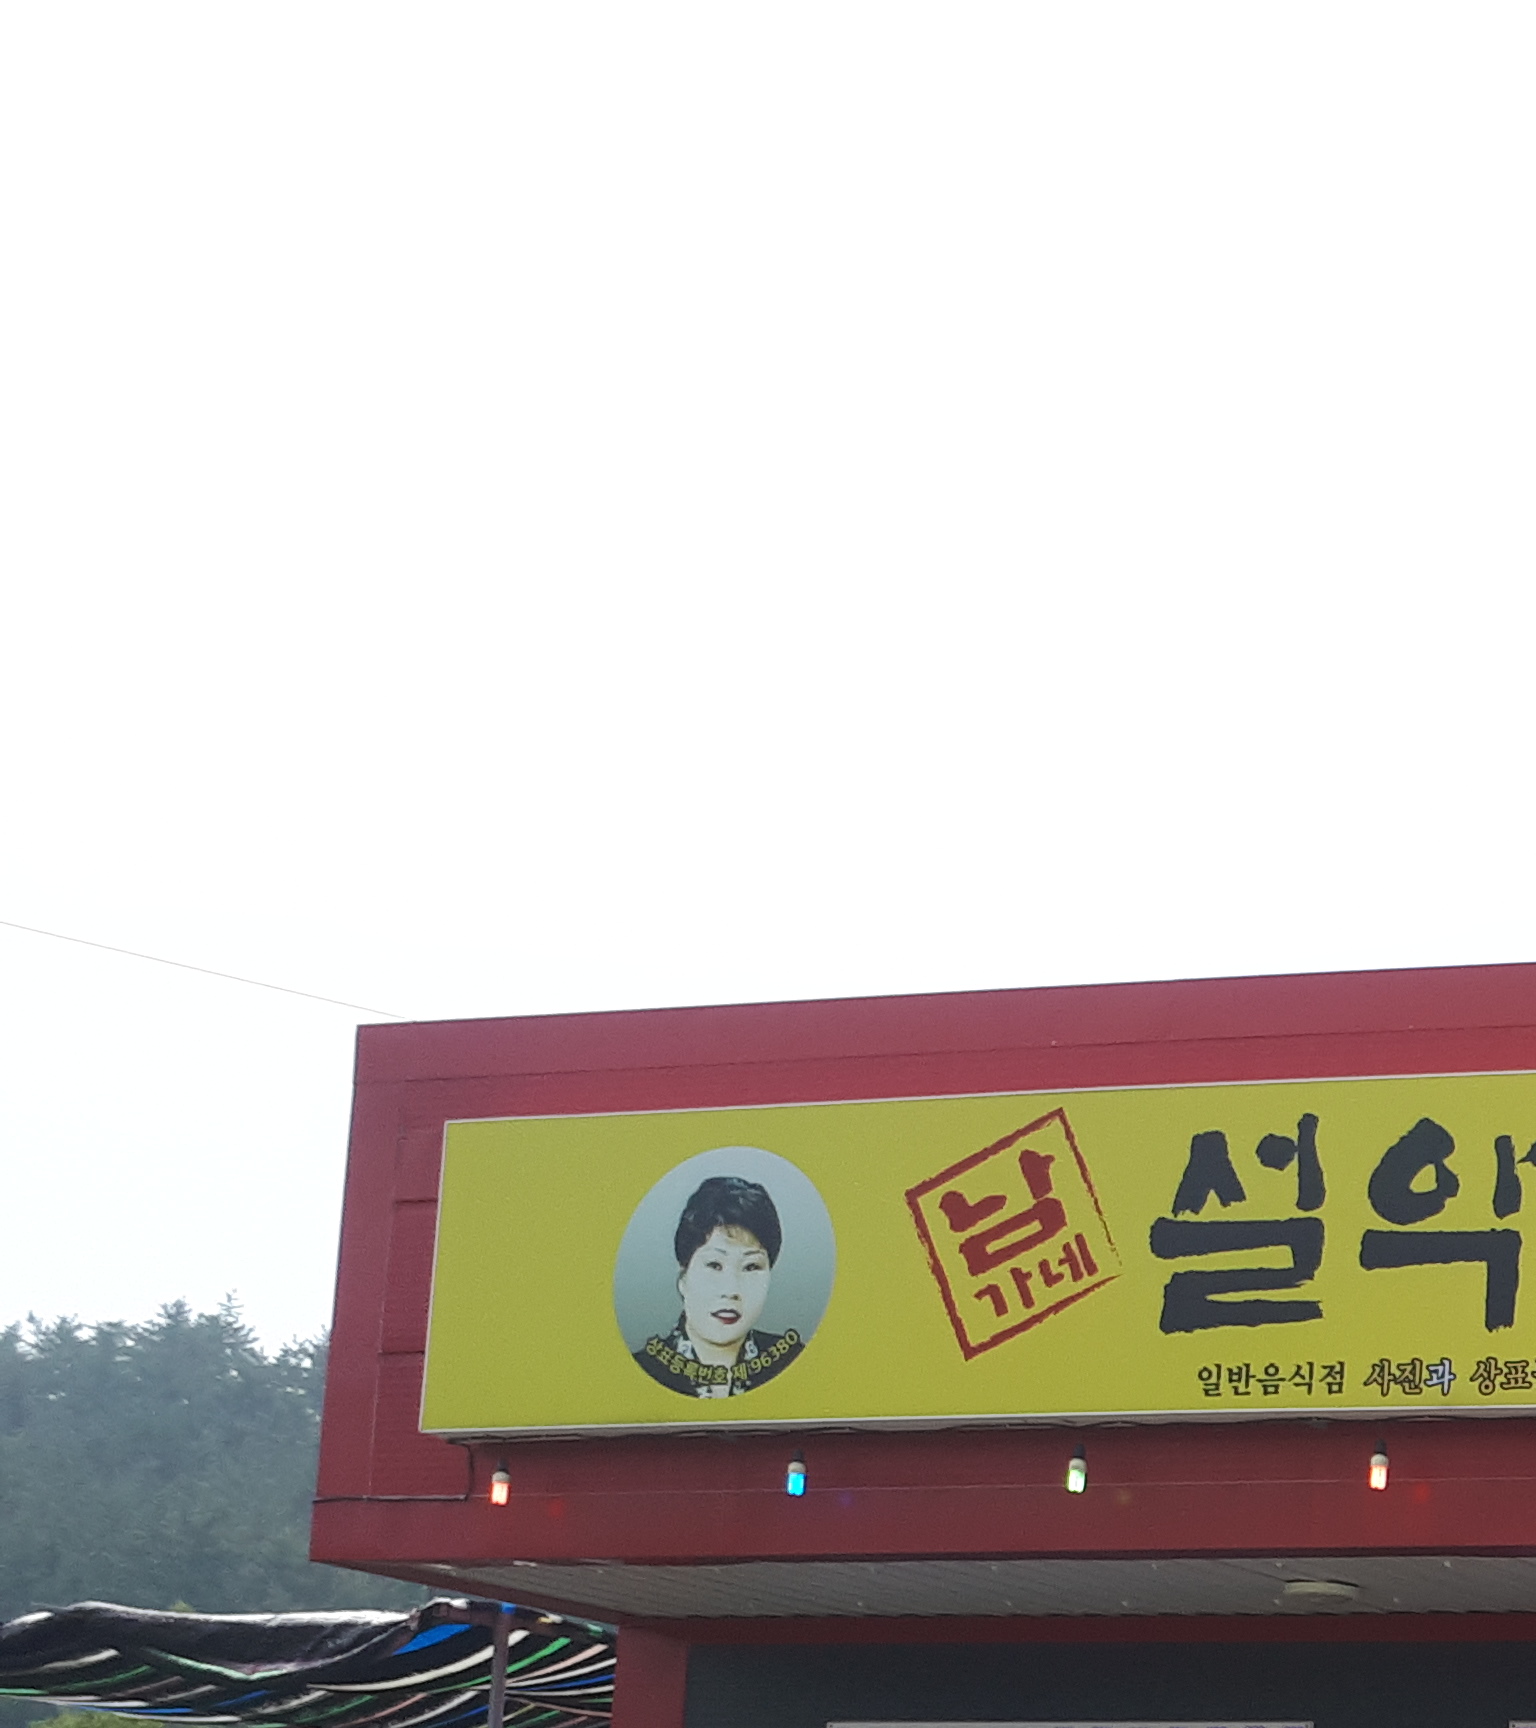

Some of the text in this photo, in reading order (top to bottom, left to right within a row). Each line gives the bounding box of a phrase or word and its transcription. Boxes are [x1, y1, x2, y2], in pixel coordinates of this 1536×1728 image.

[645, 1334, 729, 1385] 상표등록번호
[1197, 1360, 1346, 1397] 일반음식점
[1363, 1357, 1456, 1397] 사진과
